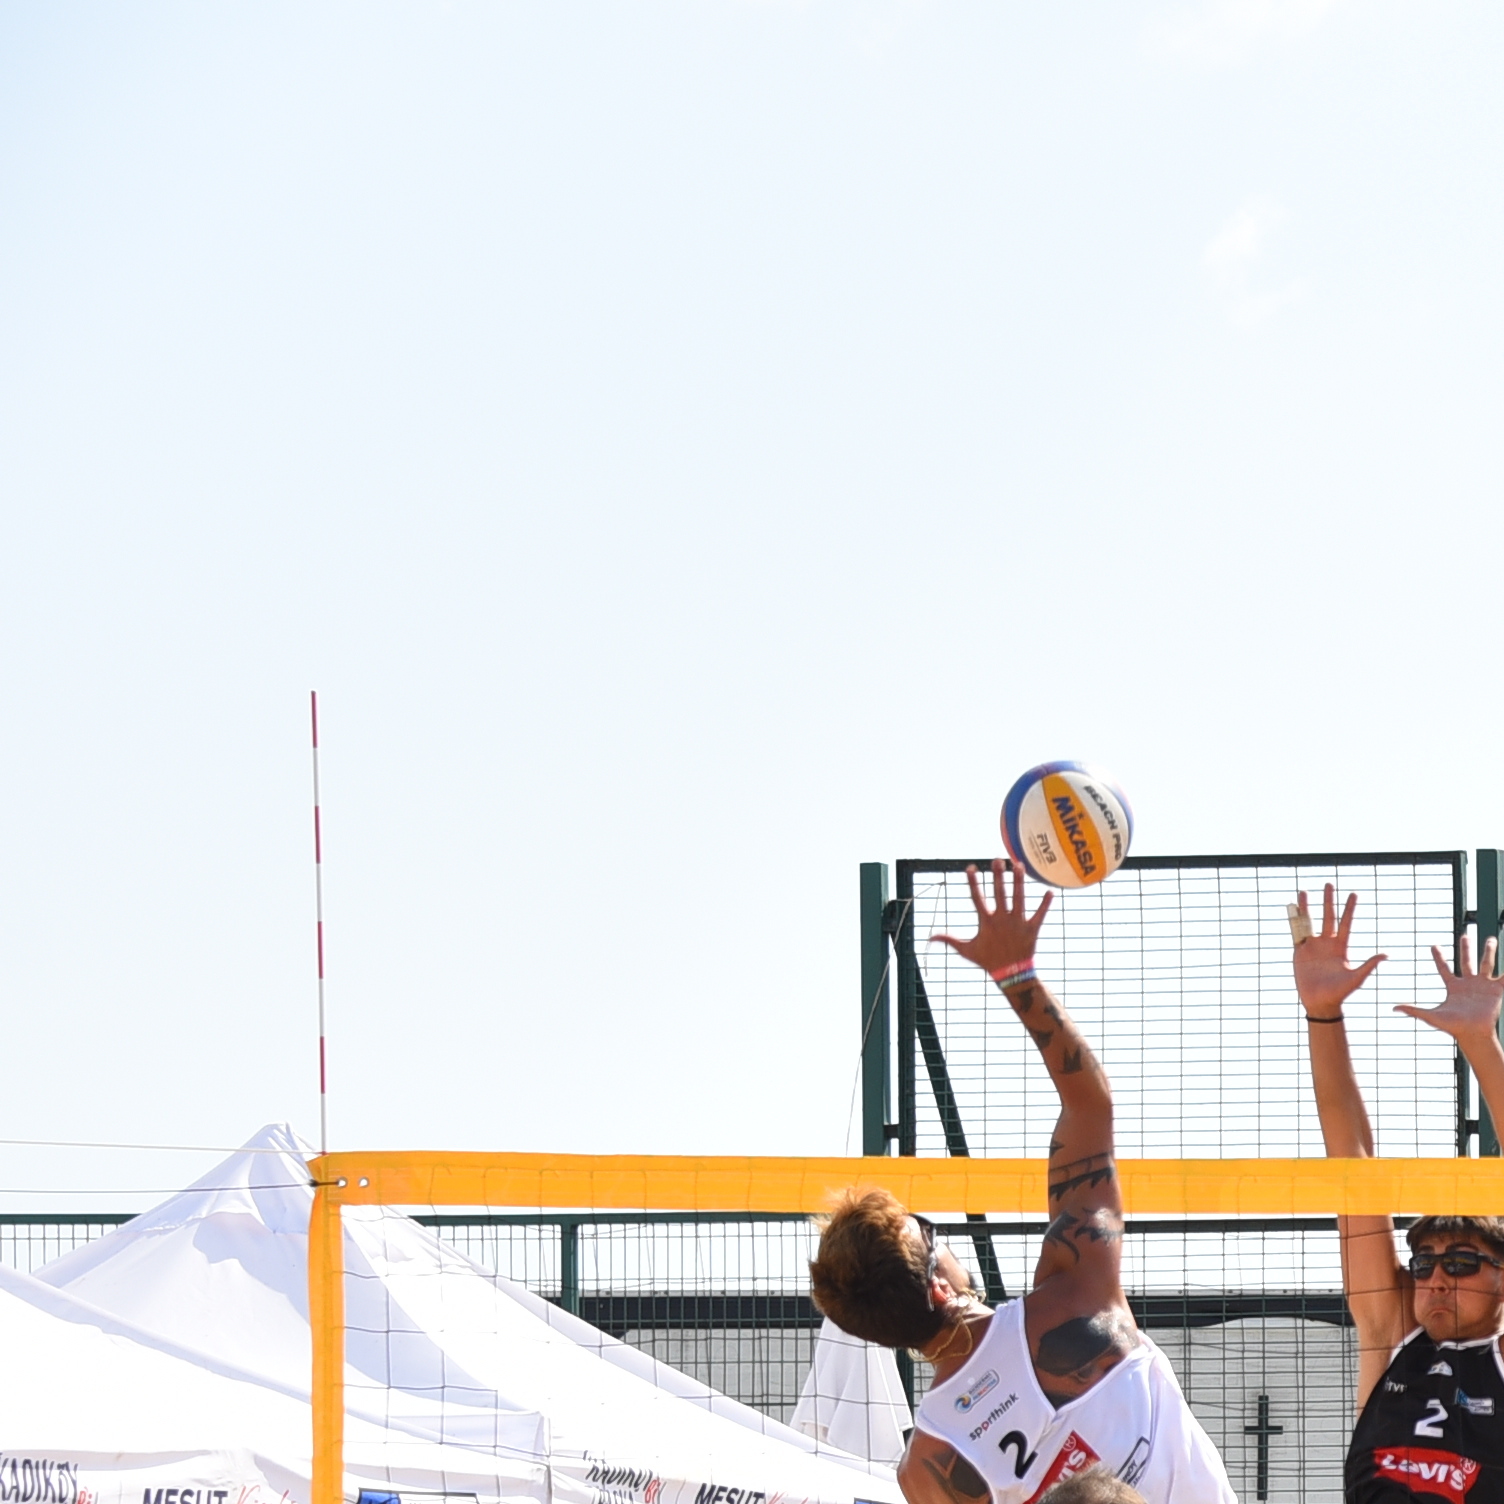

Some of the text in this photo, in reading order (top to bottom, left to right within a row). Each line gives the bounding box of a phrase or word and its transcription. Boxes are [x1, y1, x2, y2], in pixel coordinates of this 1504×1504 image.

[969, 1392, 1019, 1441] sporthink
[1414, 1399, 1448, 1438] 2
[998, 1430, 1038, 1480] 2
